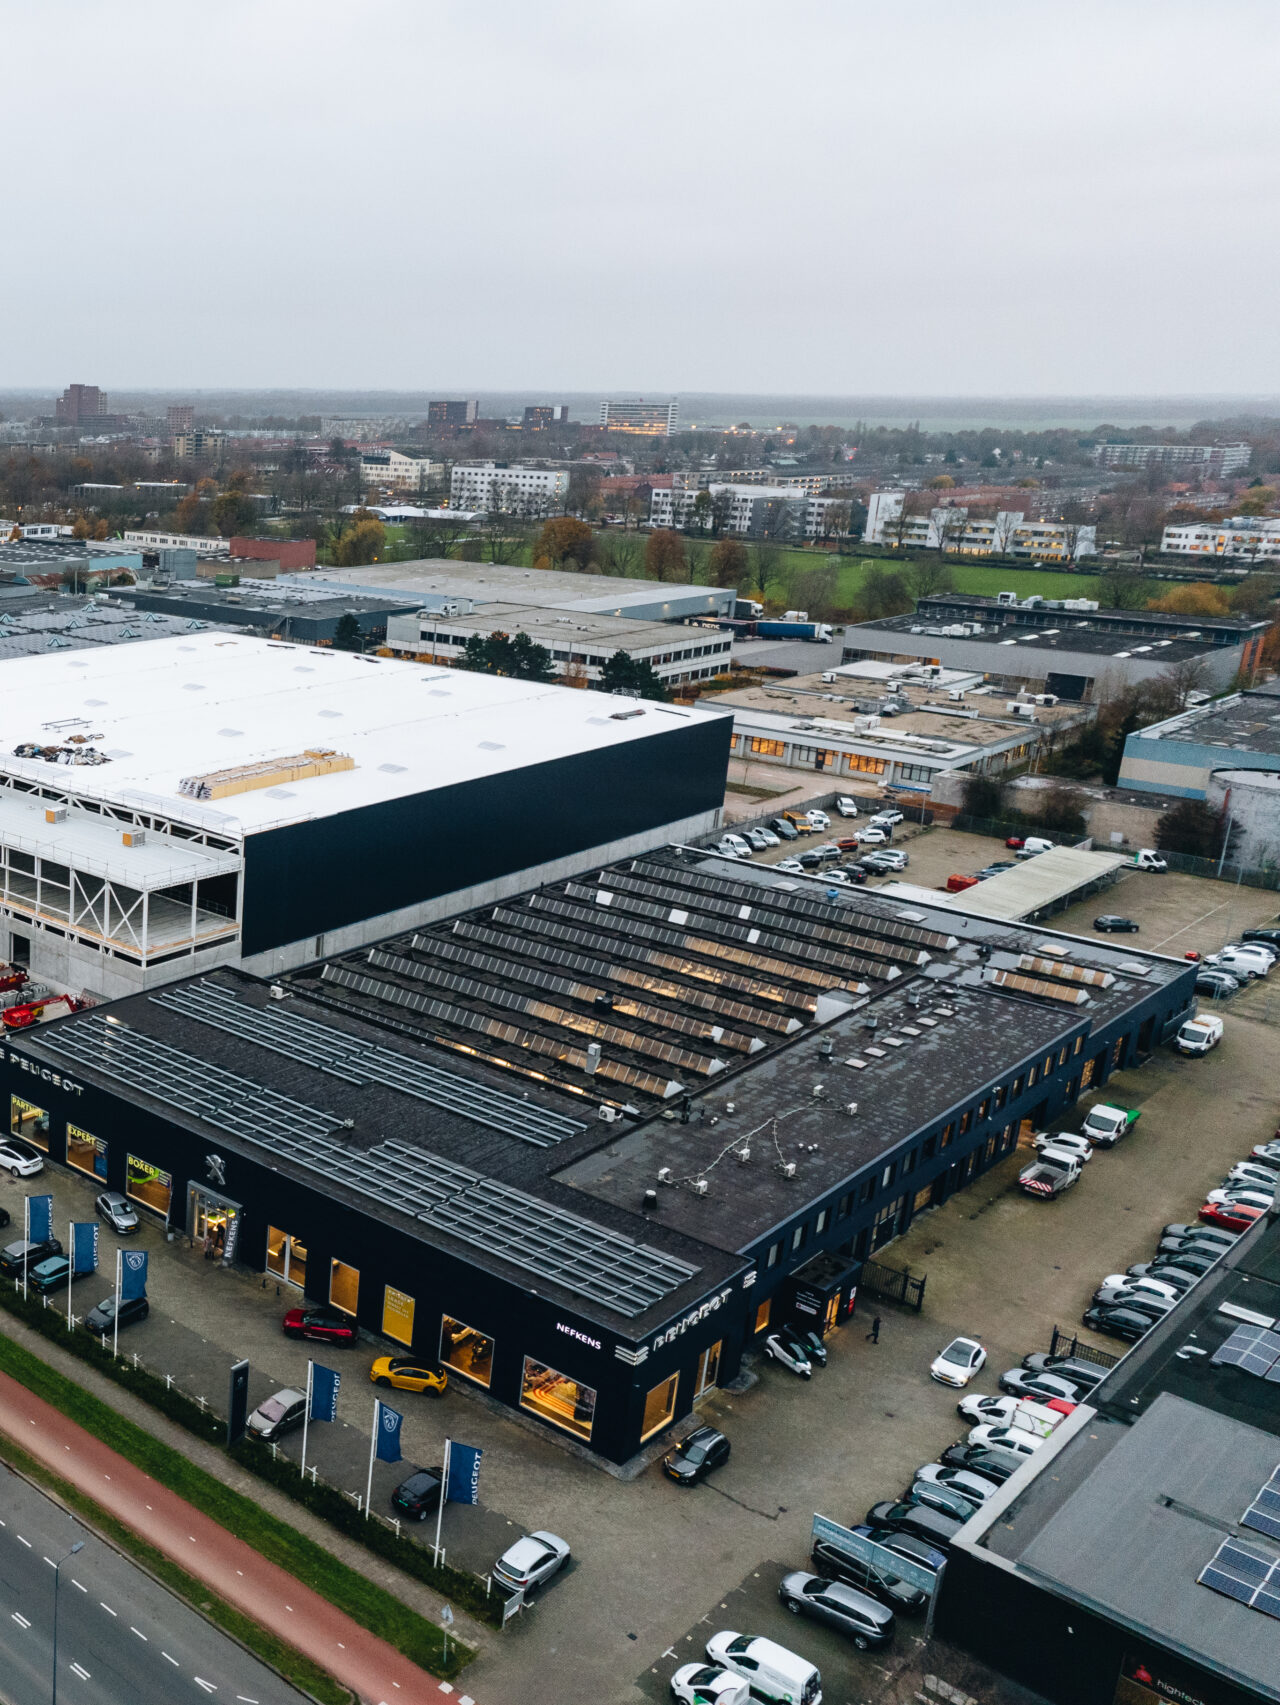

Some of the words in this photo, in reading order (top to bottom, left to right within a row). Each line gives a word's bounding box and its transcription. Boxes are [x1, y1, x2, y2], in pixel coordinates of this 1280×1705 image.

[10, 1053, 85, 1097] PEUGEOT
[67, 1125, 96, 1145] EXPERT
[128, 1156, 155, 1176] BOXER
[224, 1220, 239, 1258] NEFKENS
[556, 1322, 602, 1350] NEFKENS
[653, 1288, 733, 1351] PEUGEOT
[471, 1452, 482, 1505] PEUGEOT
